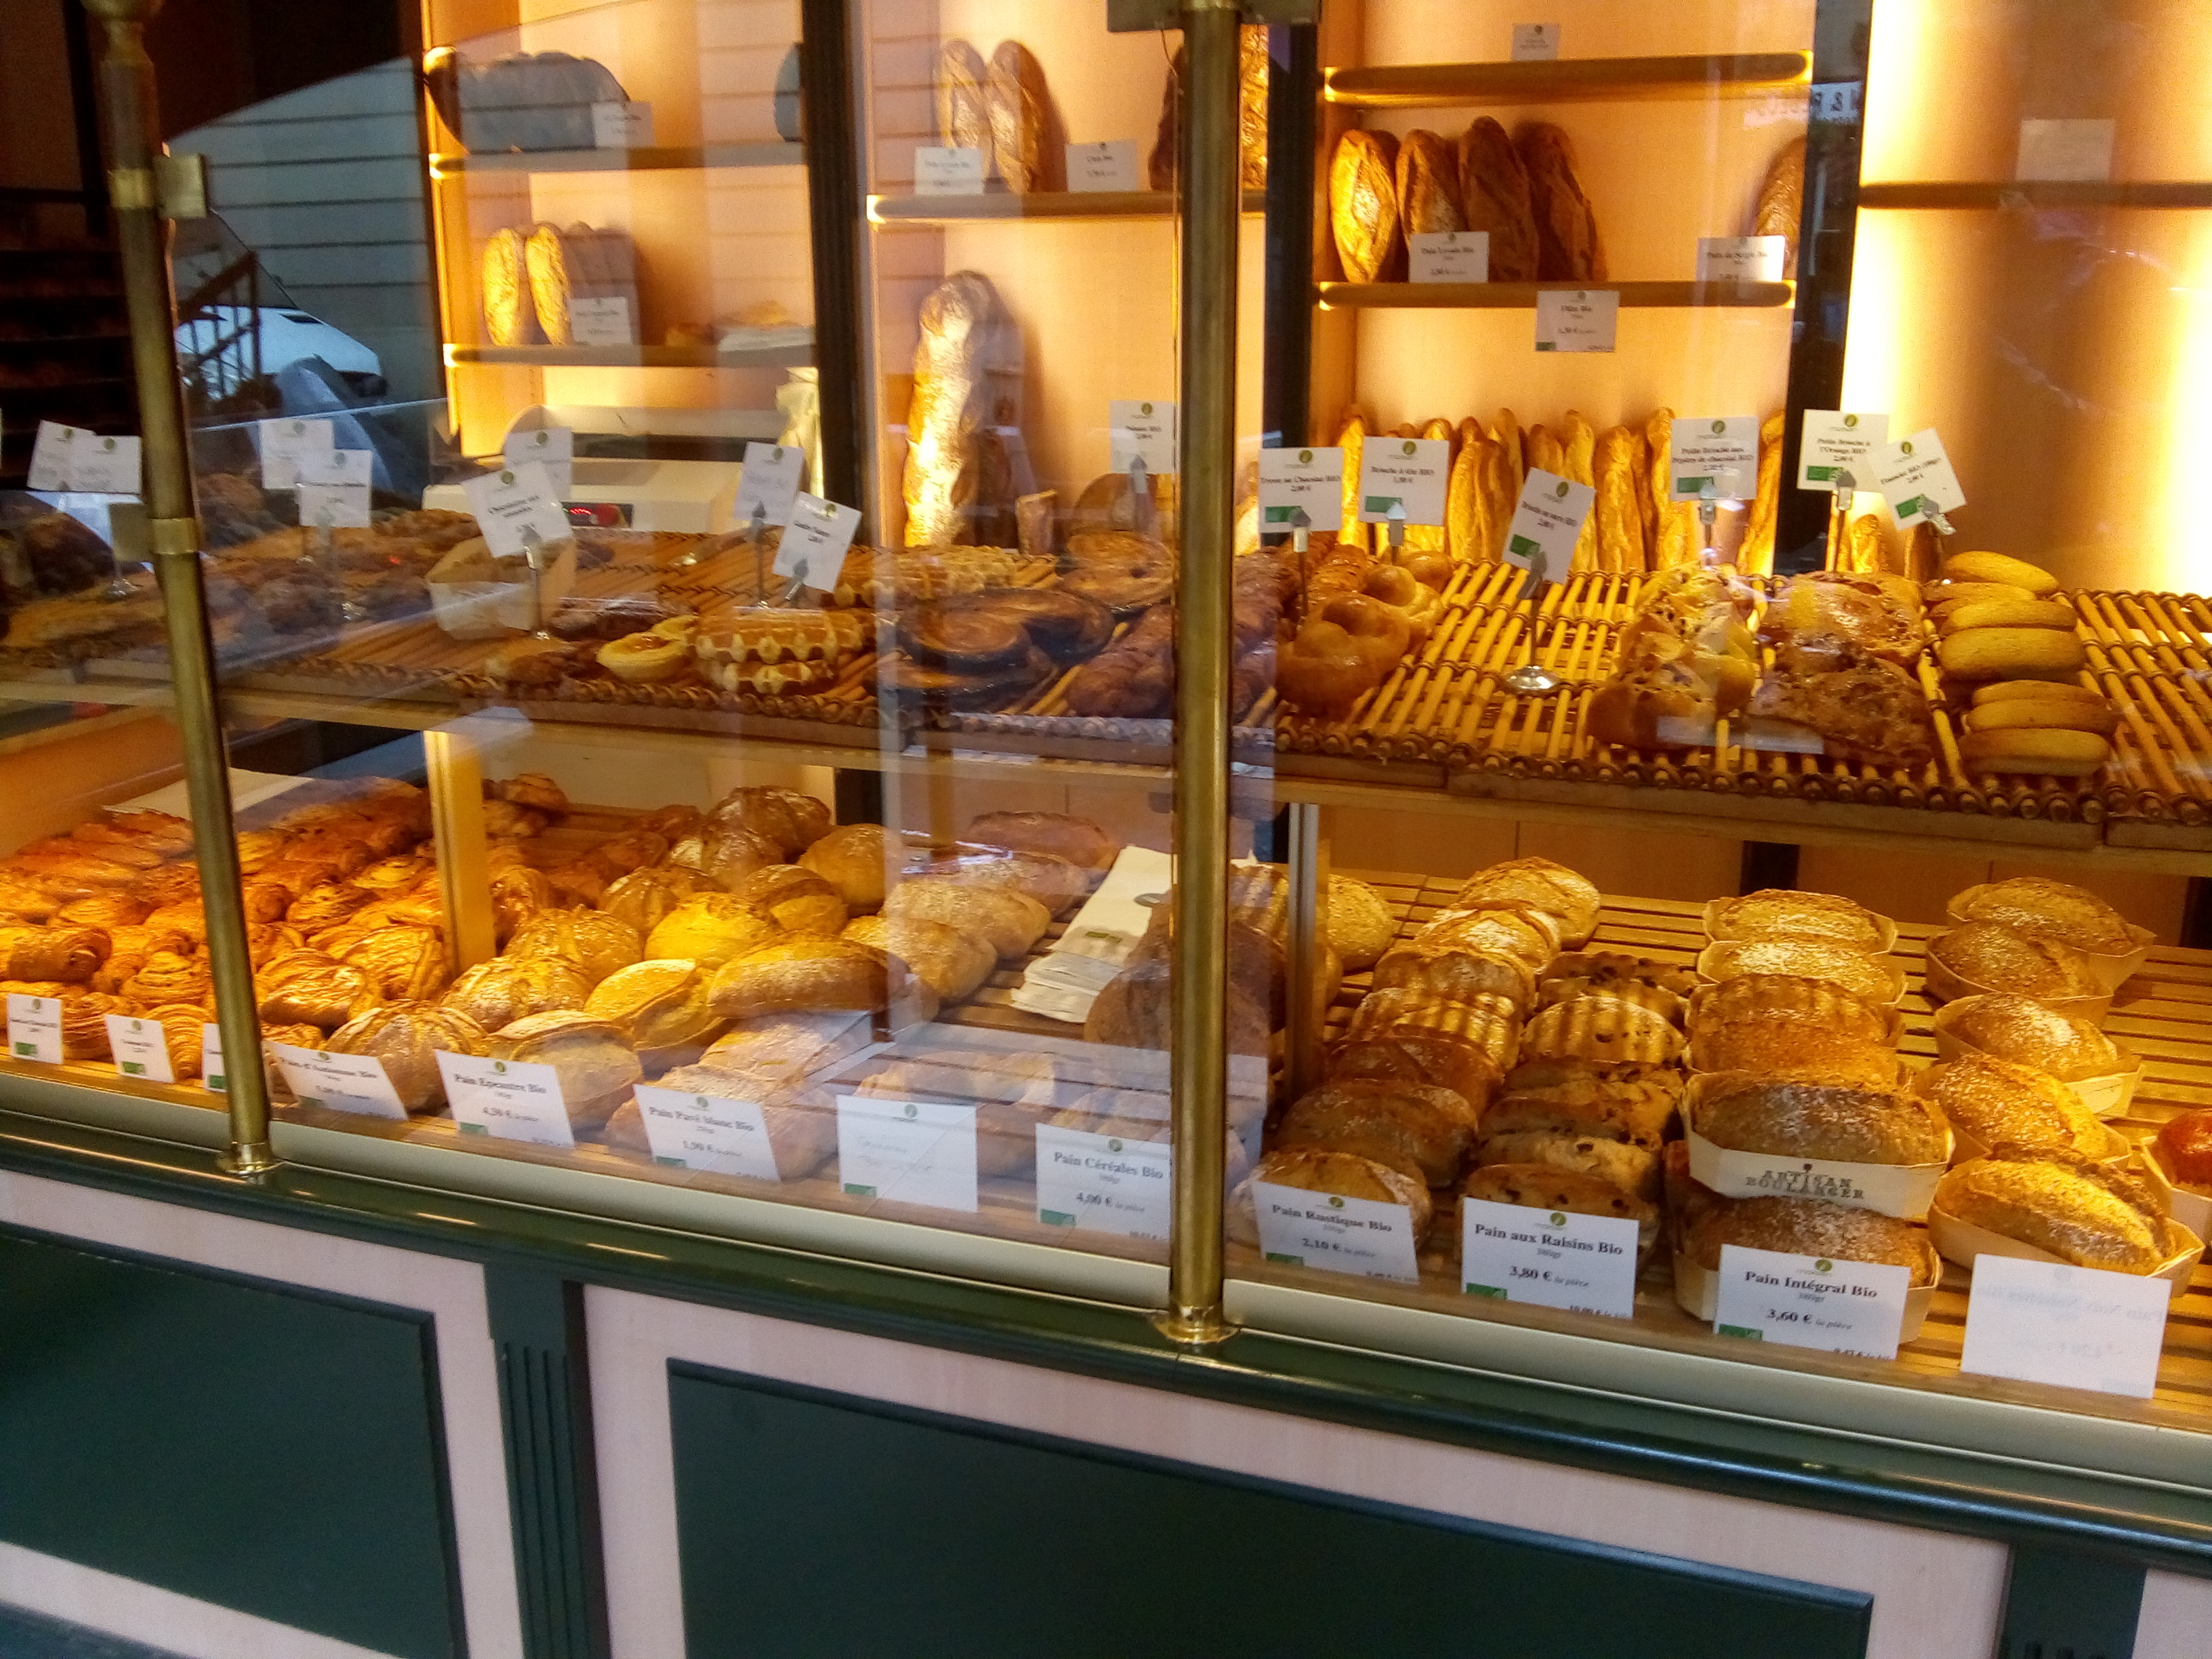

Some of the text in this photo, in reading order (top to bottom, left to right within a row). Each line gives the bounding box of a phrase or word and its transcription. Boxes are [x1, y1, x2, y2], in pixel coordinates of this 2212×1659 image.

[453, 1073, 478, 1085] Pain
[527, 1083, 548, 1094] Bio
[649, 1105, 674, 1119] Pain
[735, 1120, 755, 1132] Bio
[1054, 1151, 1163, 1179] Pain Céréales Bio
[1746, 1176, 1864, 1200] BOULANGER
[1762, 1170, 1853, 1188] ARTISAN
[1271, 1204, 1392, 1232] Pain Rustique Bio
[1475, 1223, 1624, 1255] Pain aux Raisins Bio
[1543, 1271, 1553, 1282] €
[1745, 1271, 1878, 1298] Pain Intégral Bio
[1766, 1308, 1799, 1322] 3,60
[1802, 1313, 1813, 1325] €
